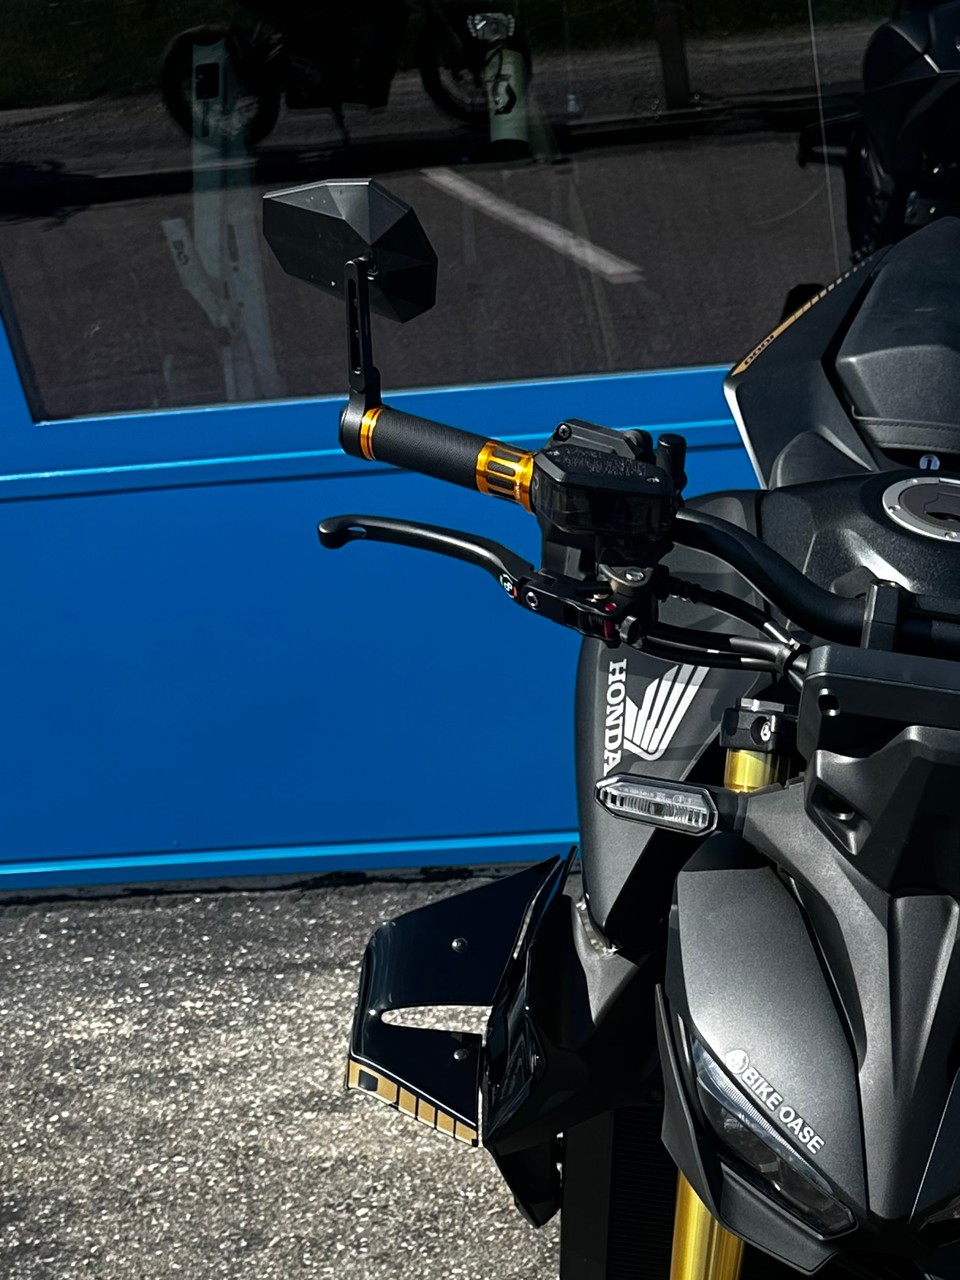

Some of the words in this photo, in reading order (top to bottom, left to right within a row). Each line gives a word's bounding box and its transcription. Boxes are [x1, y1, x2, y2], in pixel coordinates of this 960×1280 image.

[604, 659, 627, 776] HONDA
[742, 1067, 783, 1111] BIKE
[779, 1106, 825, 1154] OASE
